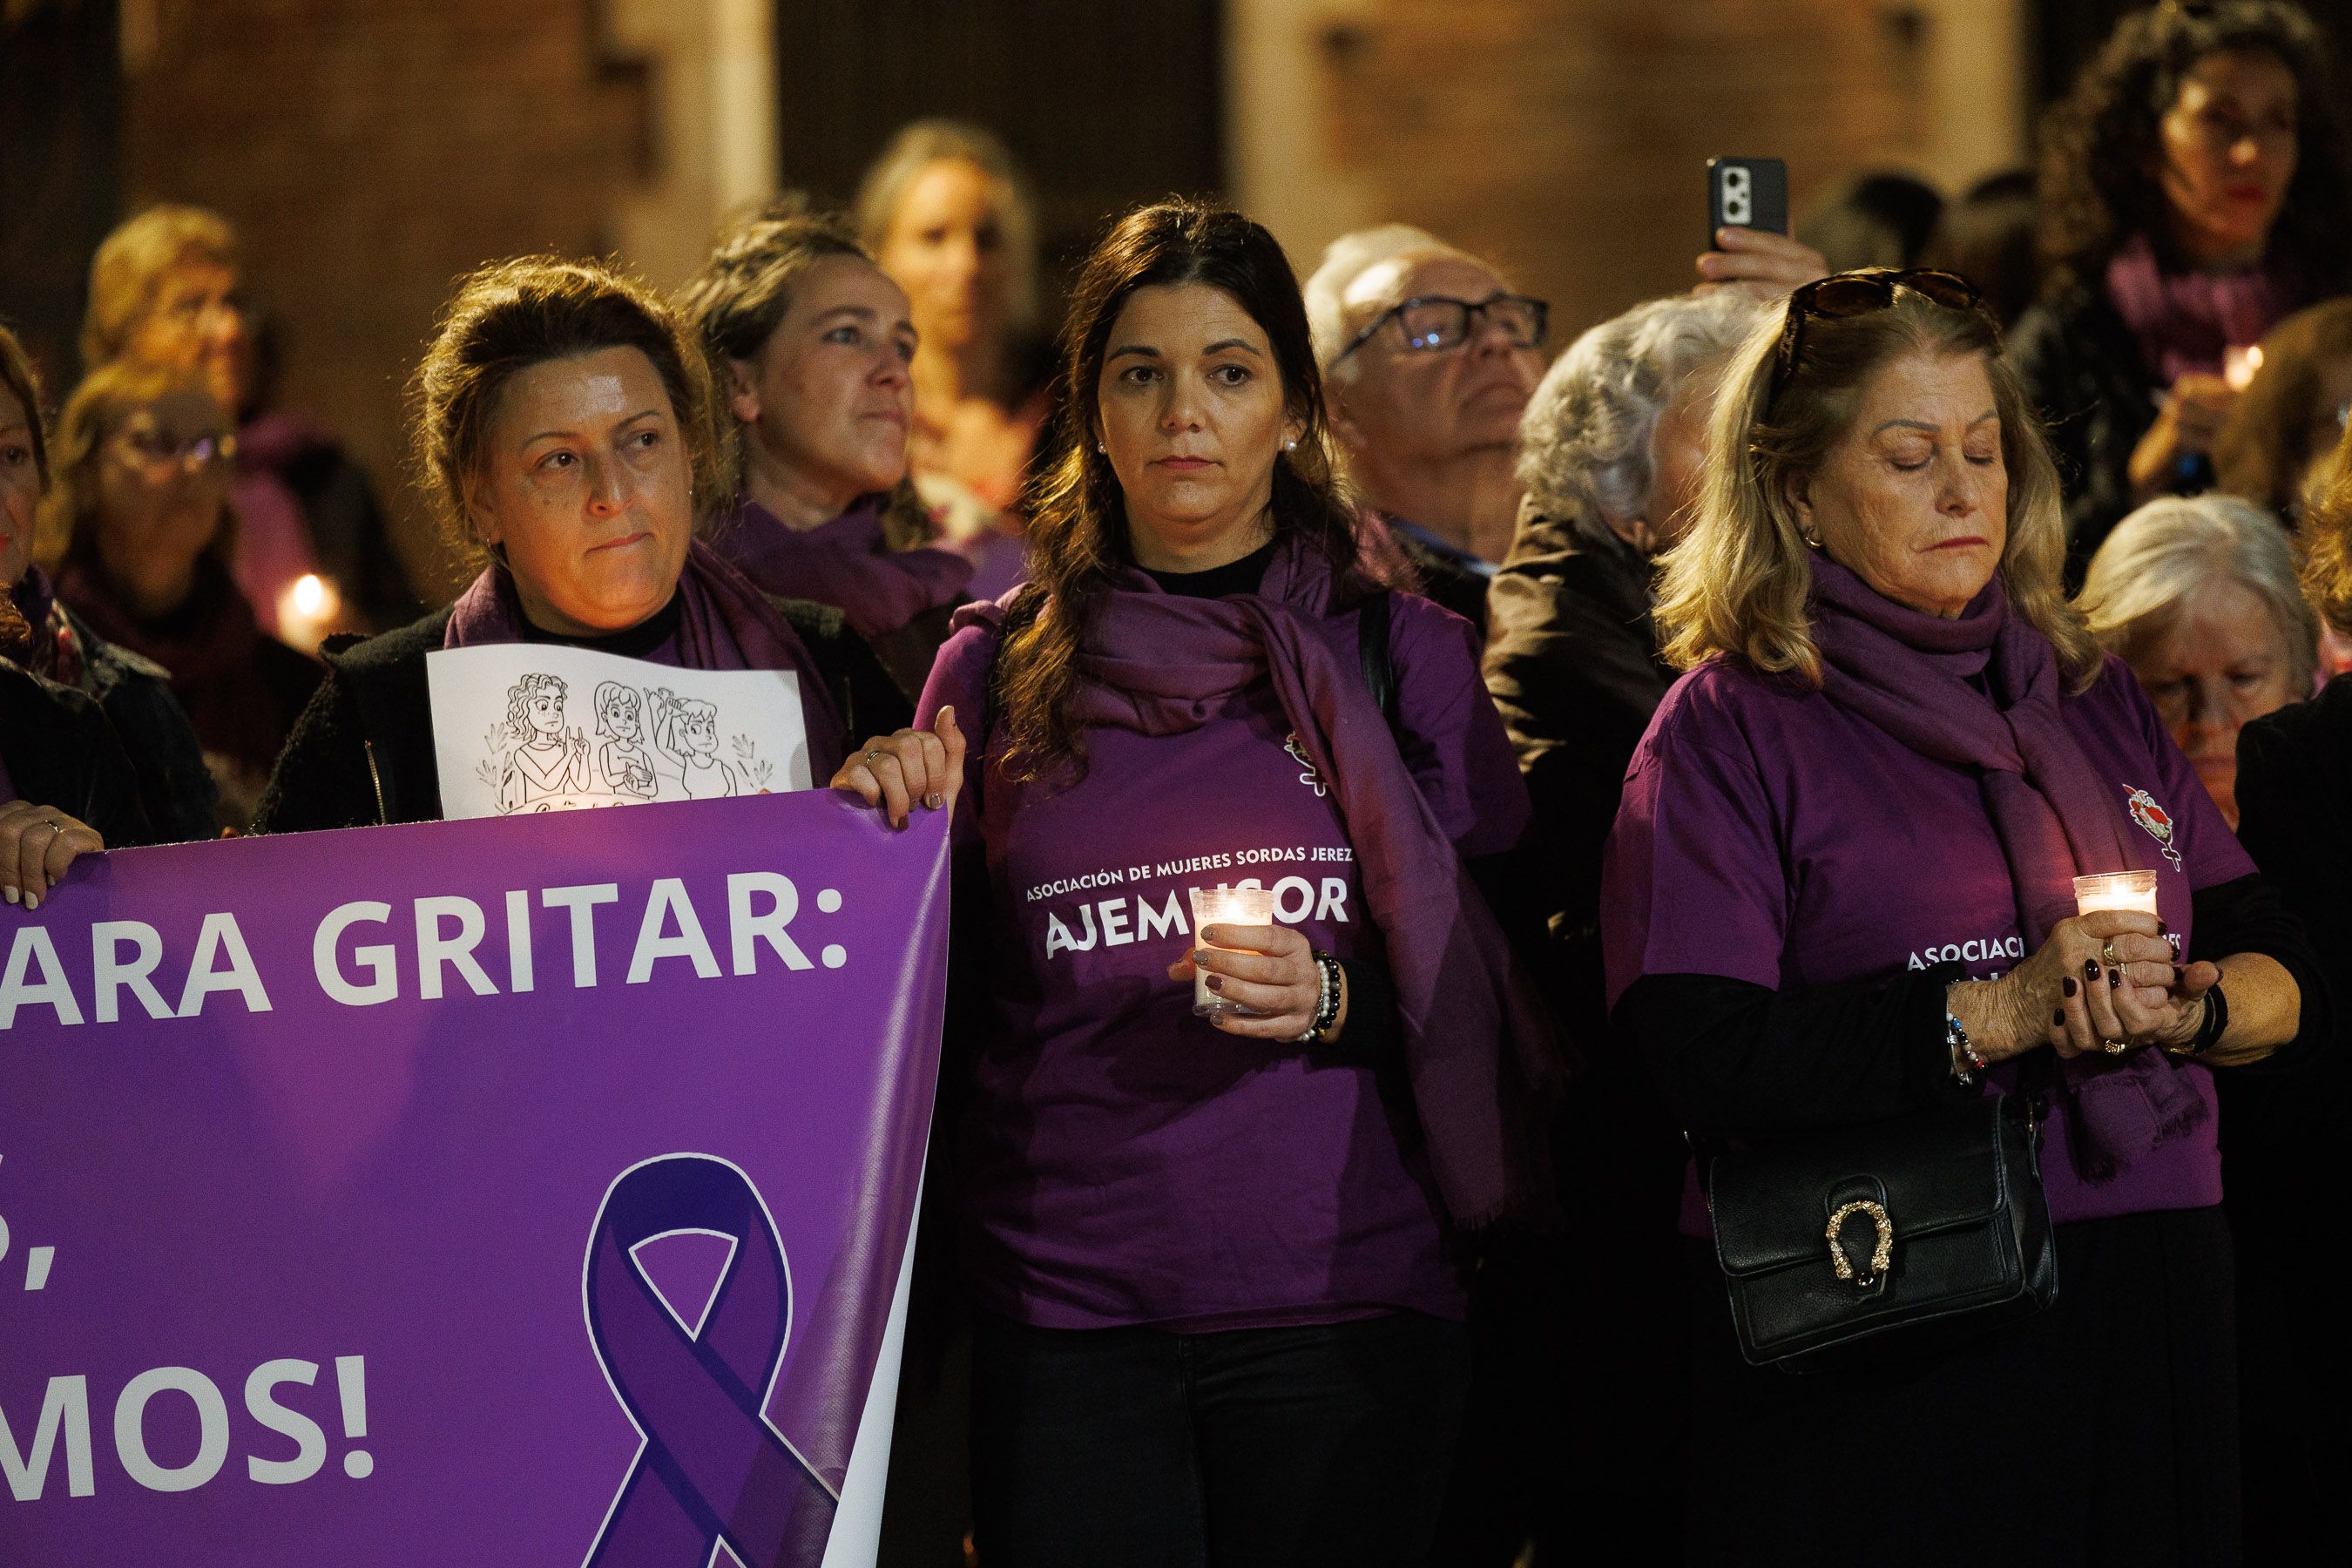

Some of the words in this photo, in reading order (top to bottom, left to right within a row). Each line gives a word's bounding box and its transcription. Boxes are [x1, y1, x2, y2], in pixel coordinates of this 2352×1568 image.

[1026, 868, 1125, 902] ASOCIACIÓN
[1128, 864, 1152, 882] DE
[1156, 852, 1232, 877] MUJERES
[1235, 846, 1306, 866] SORDAS
[1310, 847, 1353, 862] JEREZ
[313, 871, 847, 1006] GRITAR:
[1046, 875, 1349, 960] AJEMOR
[1907, 936, 2025, 971] ASOCIACI
